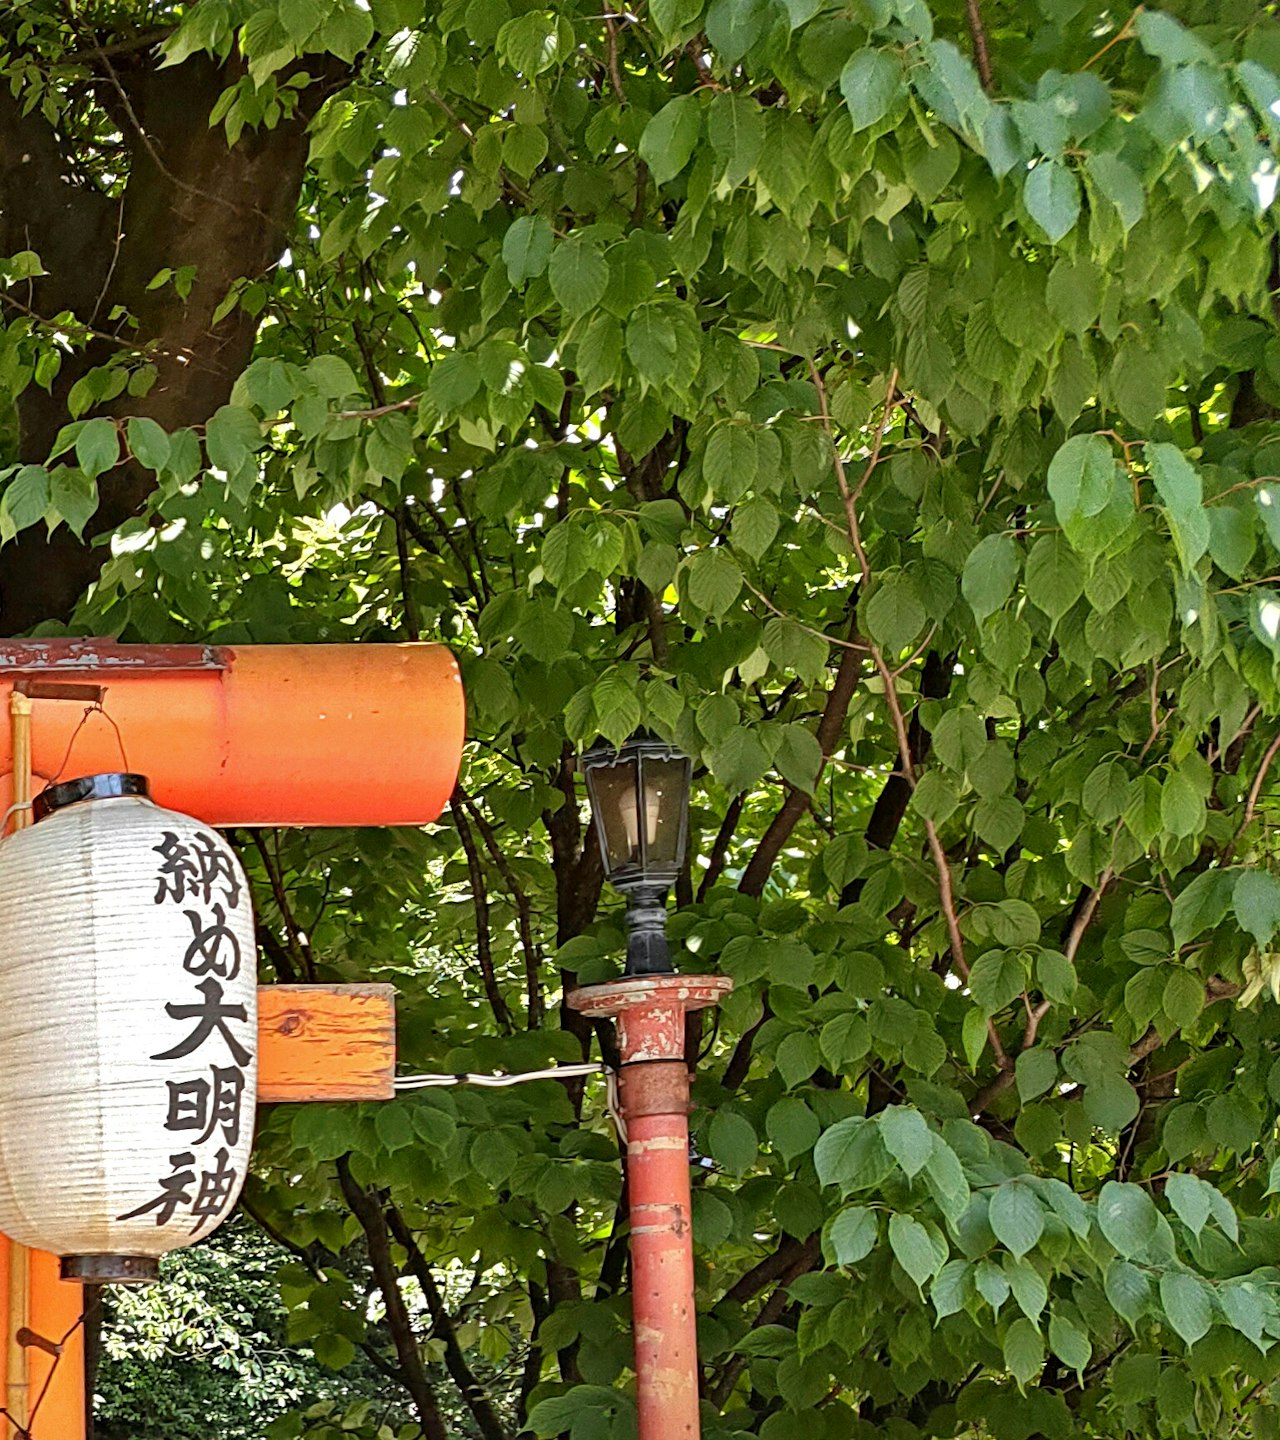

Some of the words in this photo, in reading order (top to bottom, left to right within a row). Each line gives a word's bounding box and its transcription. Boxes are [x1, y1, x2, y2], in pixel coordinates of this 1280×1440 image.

[115, 830, 253, 1236] 納め大明神
